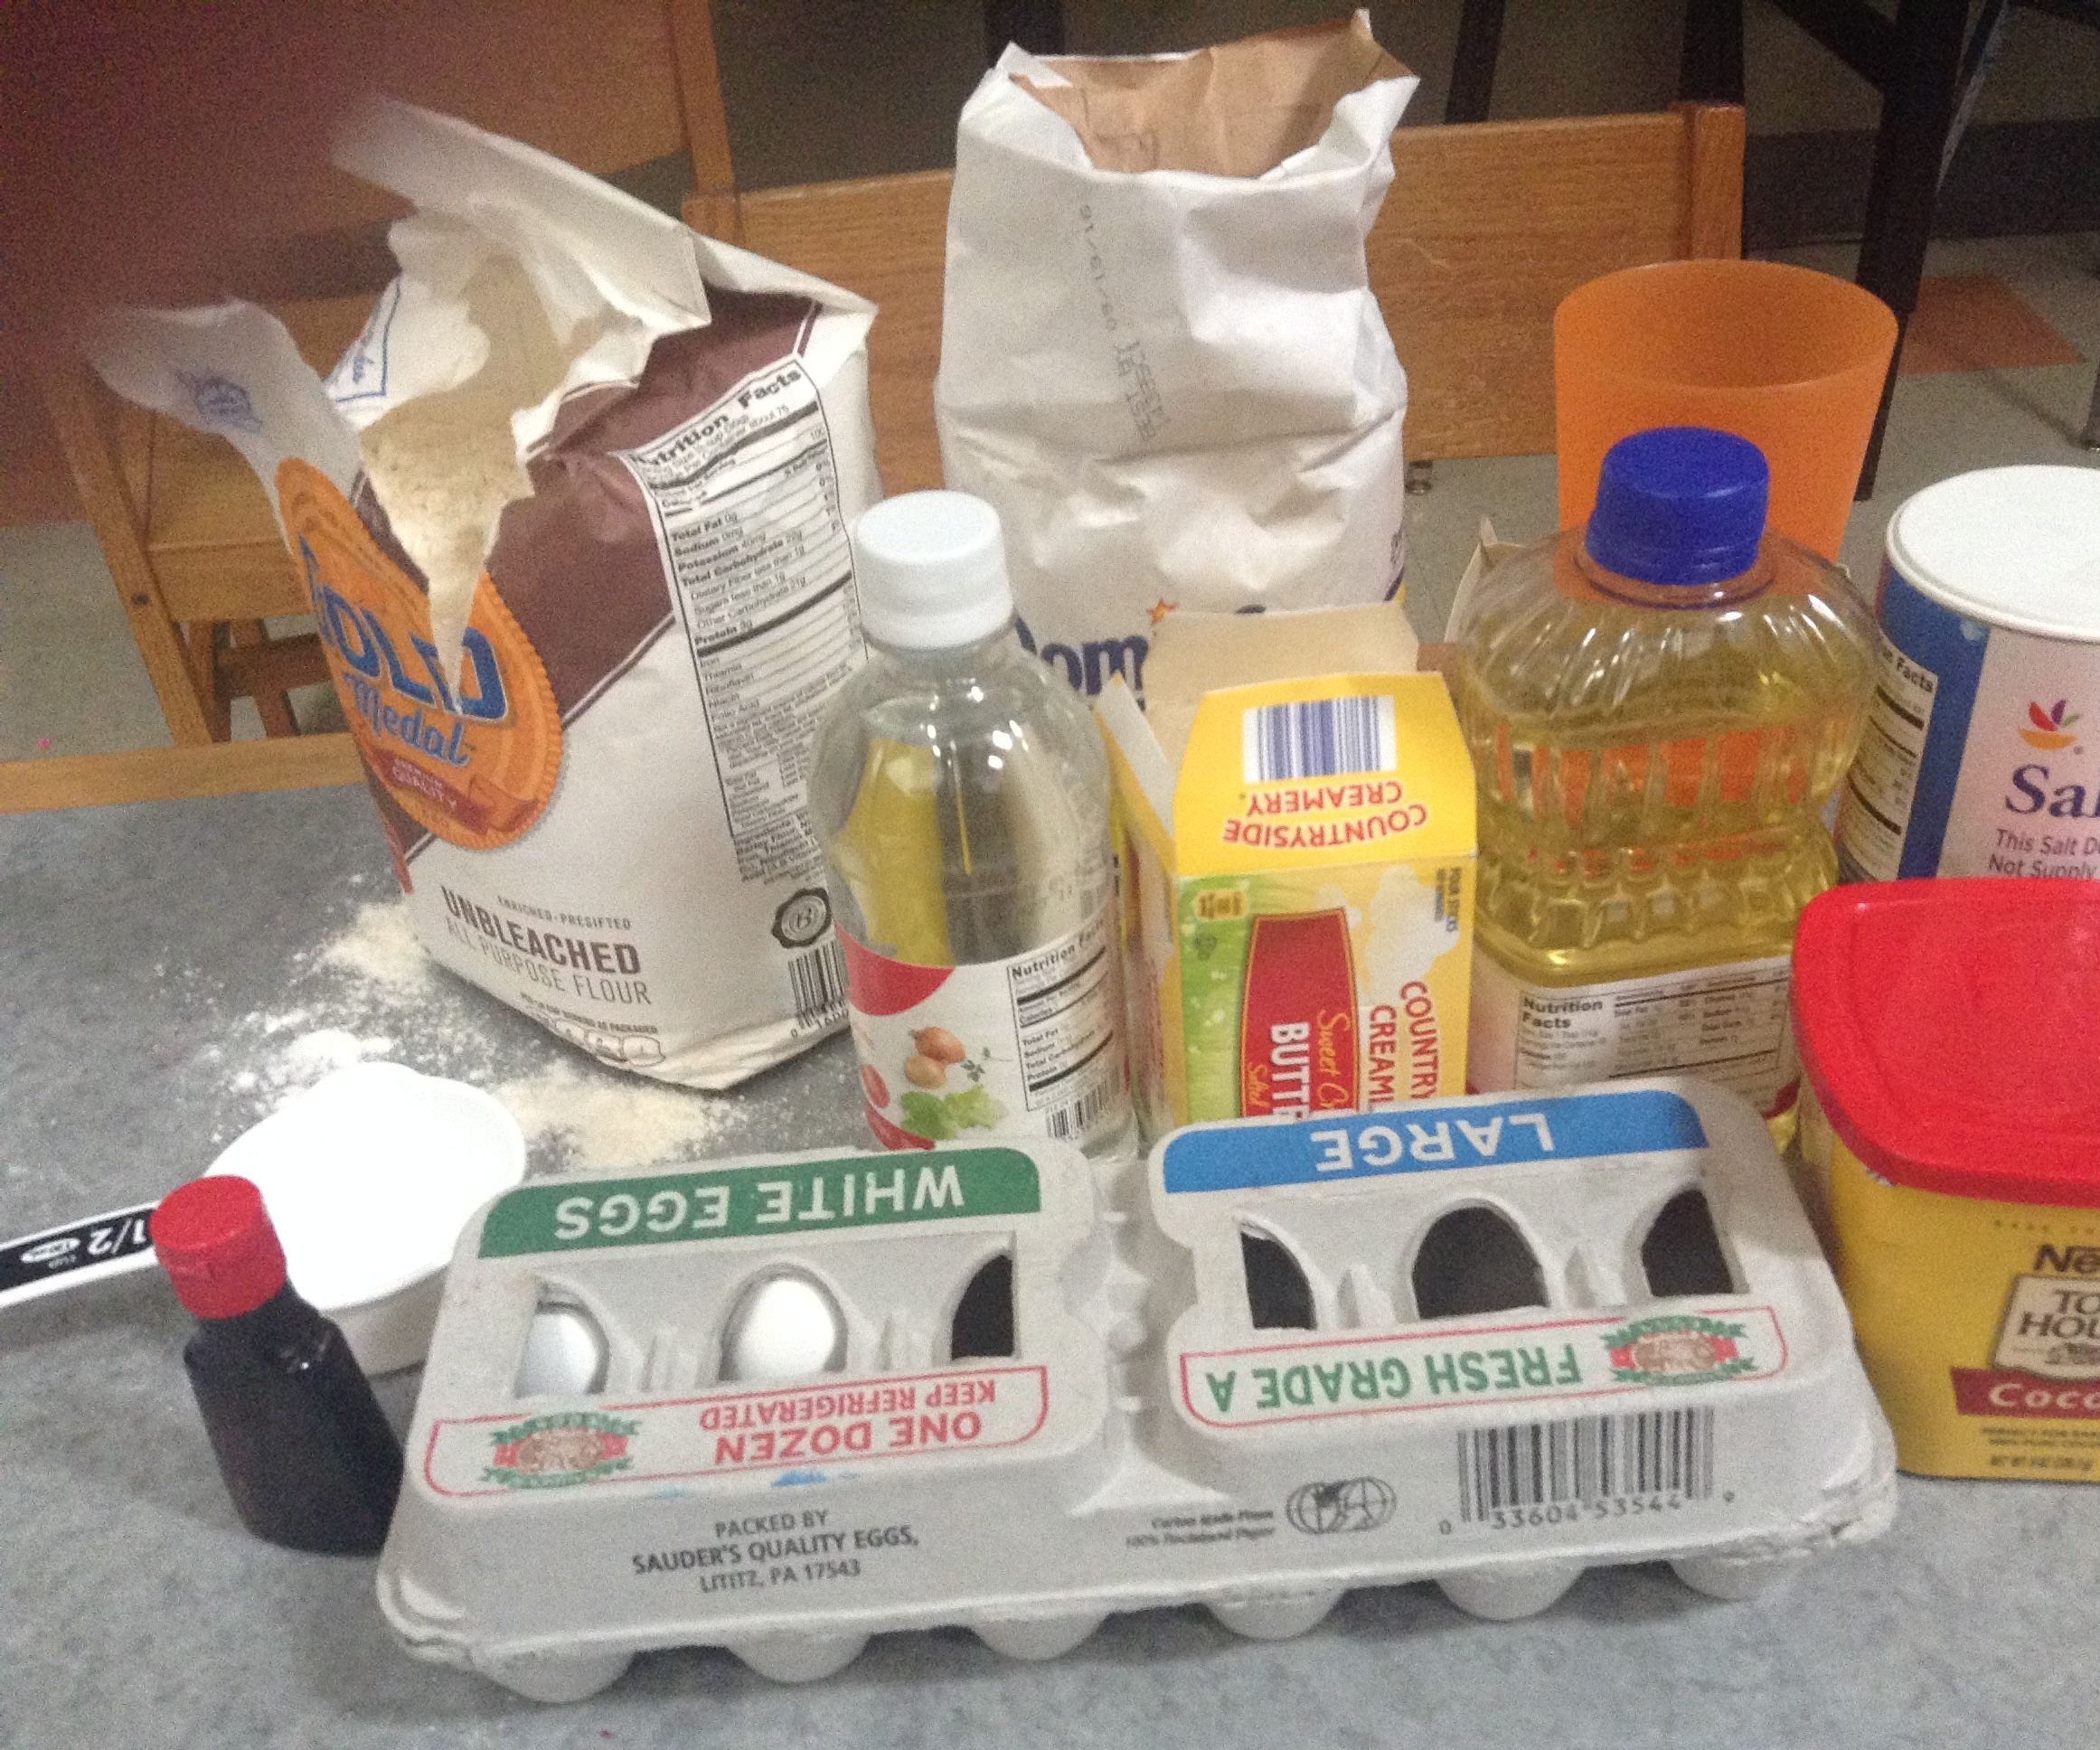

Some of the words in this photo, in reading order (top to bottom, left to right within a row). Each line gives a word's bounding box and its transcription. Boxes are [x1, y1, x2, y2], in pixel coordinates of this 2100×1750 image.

[738, 369, 802, 408] Facts
[671, 526, 702, 542] Total
[703, 518, 722, 532] Fat
[683, 571, 712, 588] Total
[713, 540, 785, 576] Carbohydrate
[694, 626, 739, 647] Protein
[342, 672, 472, 767] Medal
[1221, 803, 1428, 848] COUNTRYSIDE
[1996, 827, 2036, 853] This
[2039, 834, 2078, 856] Salt
[1989, 852, 2025, 880] Not
[440, 884, 642, 974] UNBLEACHED
[480, 935, 566, 992] PURPOSE
[572, 974, 652, 1005] FLOUR
[1012, 944, 1075, 980] Nutrition
[1522, 1011, 1572, 1029] Facts
[1523, 996, 1604, 1014] Nutrition
[1316, 1008, 1351, 1076] Sweet
[1312, 1112, 1555, 1174] LARGE
[554, 1187, 730, 1240] EGGS
[756, 1165, 965, 1224] WHITE
[88, 1218, 148, 1256] 1/2
[1257, 1357, 1410, 1407] GRADE
[1427, 1342, 1581, 1390] FRESH
[699, 1387, 918, 1431] REFRIGERATED
[925, 1379, 997, 1410] KEEP
[1205, 1369, 1238, 1412] A
[714, 1419, 872, 1465] DOZEN
[888, 1411, 983, 1444] ONE
[714, 1512, 796, 1538] PACKED
[801, 1510, 829, 1529] BY
[1438, 1519, 1453, 1536] 0
[1490, 1504, 1577, 1531] 33604
[1594, 1494, 1681, 1519] 53544
[632, 1543, 742, 1575] SAUDER'S
[747, 1532, 846, 1562] QUALITY
[769, 1565, 798, 1585] PA
[804, 1557, 861, 1581] 17543
